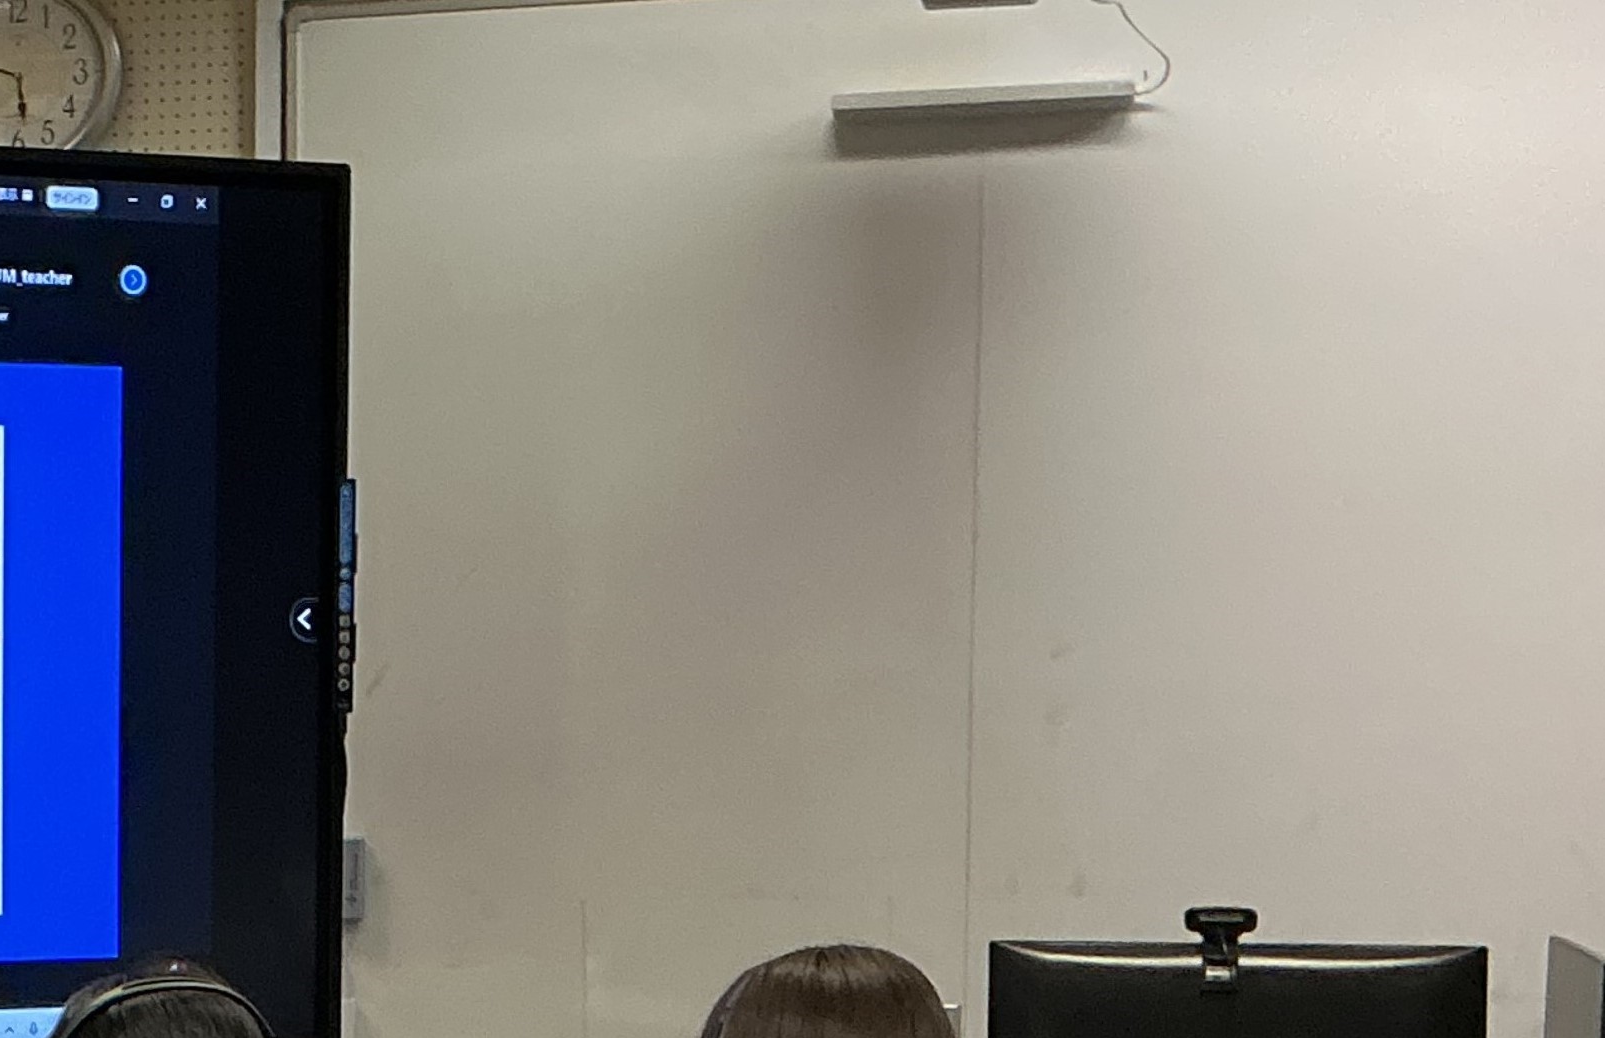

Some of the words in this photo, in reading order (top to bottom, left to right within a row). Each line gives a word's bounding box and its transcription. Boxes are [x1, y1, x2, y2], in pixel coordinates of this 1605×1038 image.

[9, 0, 28, 24] 12
[63, 23, 77, 50] 2
[73, 58, 89, 85] 3
[62, 94, 76, 118] 4
[41, 120, 55, 145] 5
